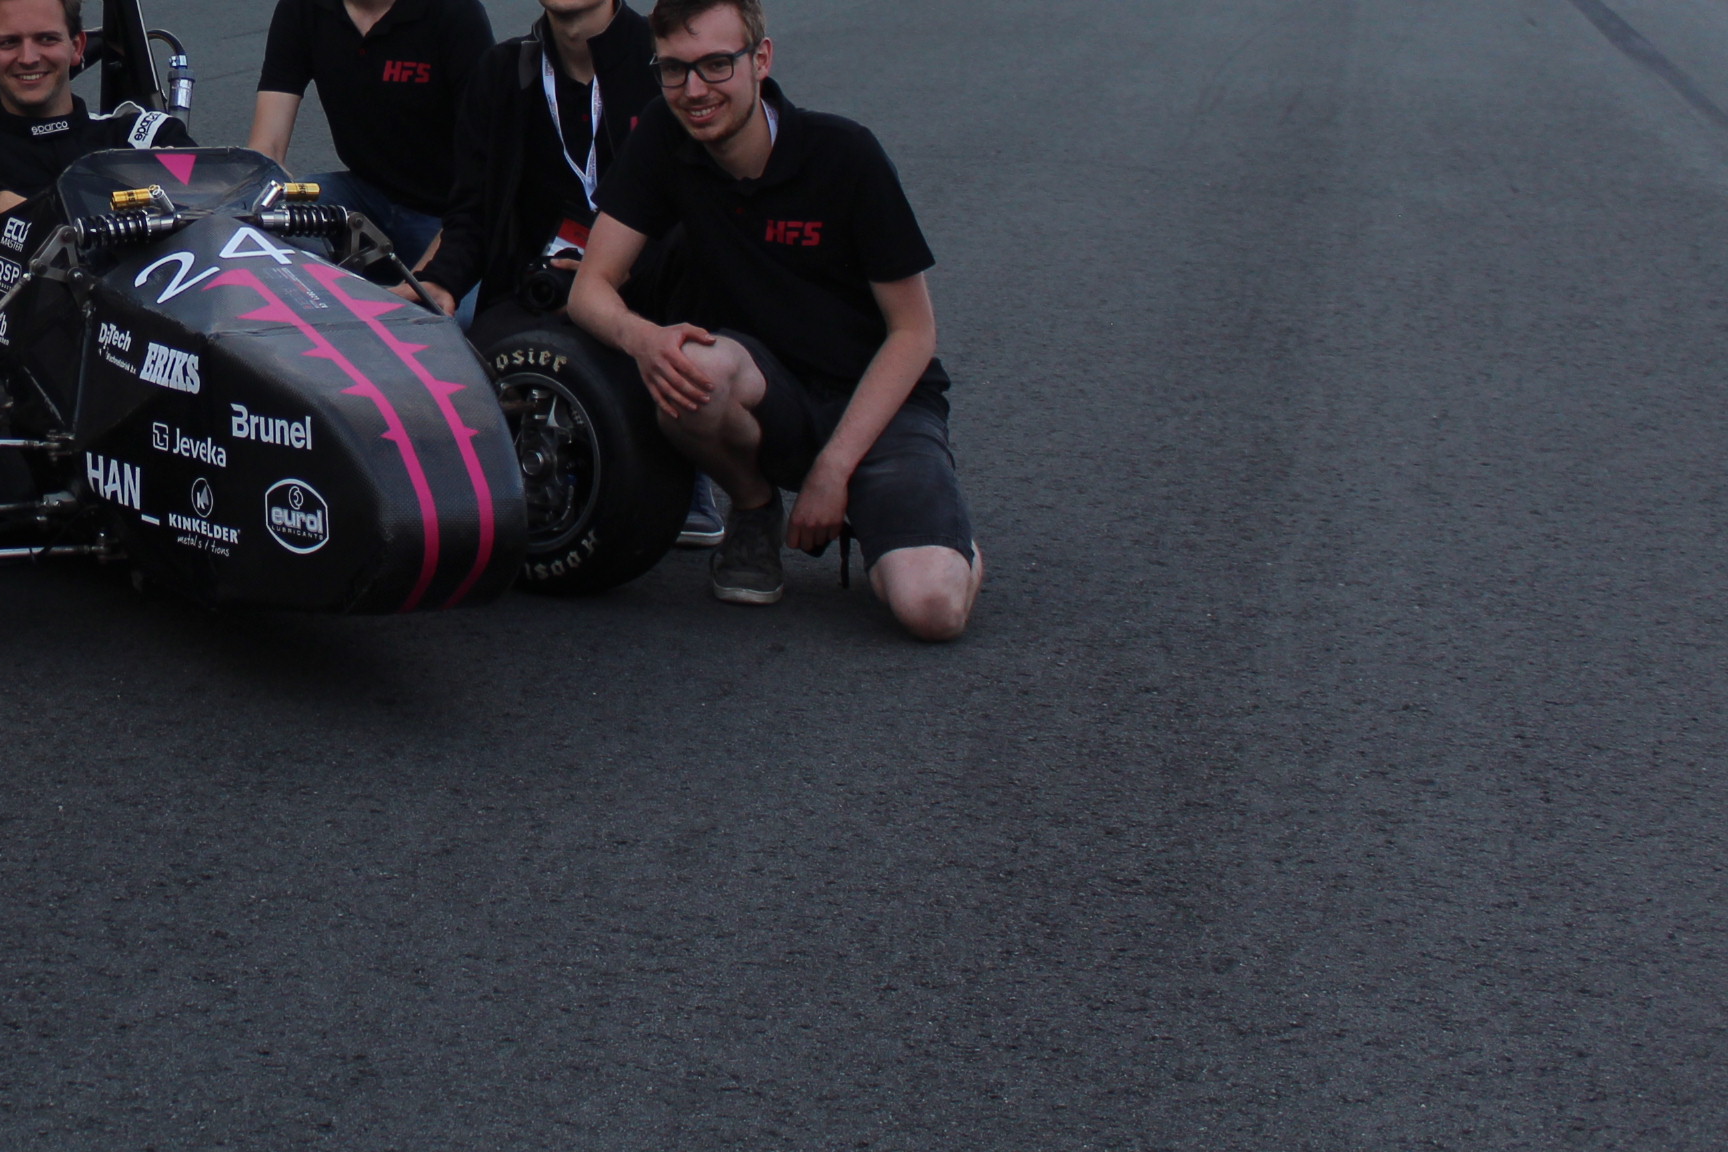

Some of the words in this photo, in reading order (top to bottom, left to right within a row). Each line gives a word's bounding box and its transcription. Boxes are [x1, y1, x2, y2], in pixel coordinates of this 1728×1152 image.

[382, 60, 432, 84] HFS
[31, 119, 70, 136] sparco
[4, 217, 32, 243] ECU
[765, 219, 825, 247] HFS
[0, 236, 24, 252] MASTER
[134, 226, 295, 304] 24
[139, 342, 201, 394] ERIKS
[495, 348, 569, 374] osier
[230, 402, 312, 451] Brunel
[173, 427, 227, 468] Jeveka
[271, 506, 323, 534] eurol
[271, 525, 325, 541] LUBRICANTS
